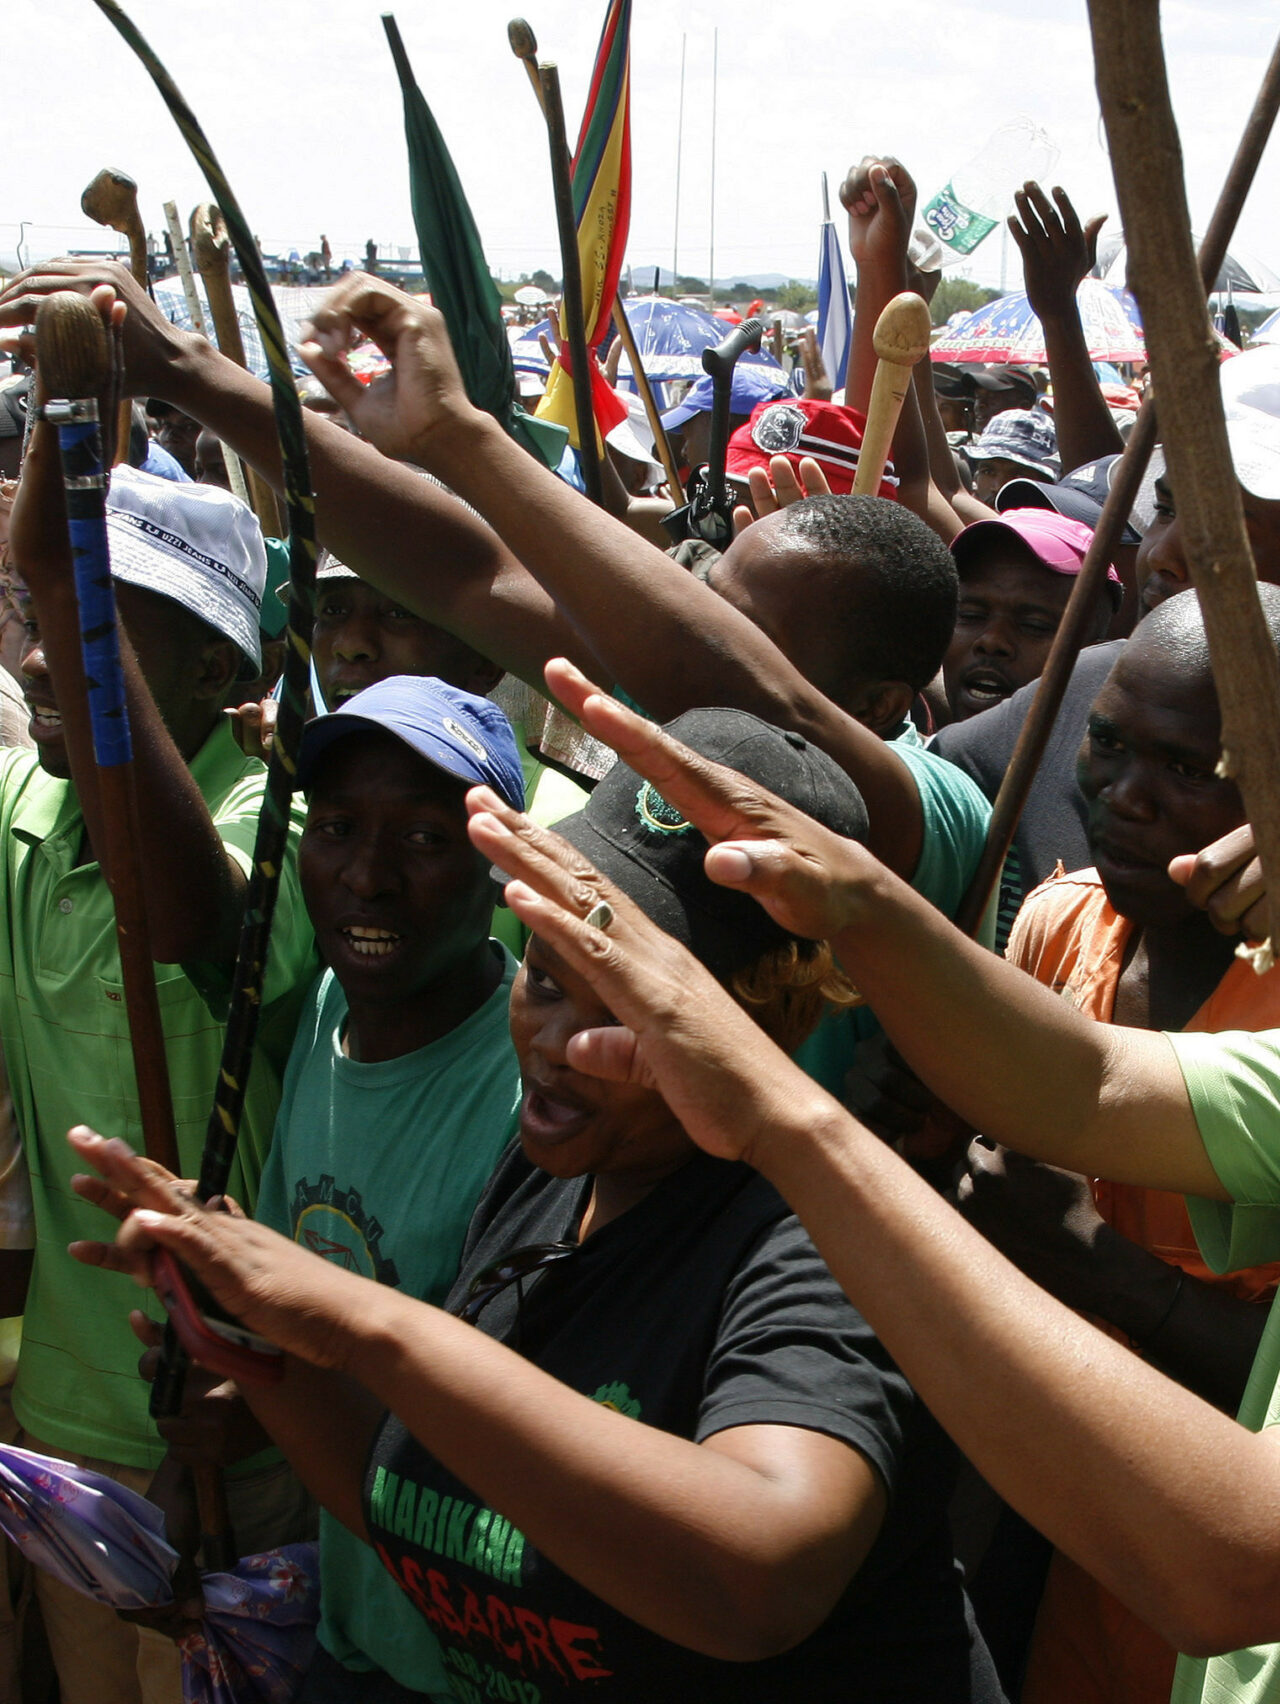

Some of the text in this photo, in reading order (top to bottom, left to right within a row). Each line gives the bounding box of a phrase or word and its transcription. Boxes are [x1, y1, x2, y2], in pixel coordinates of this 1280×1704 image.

[161, 533, 182, 548] UZZI
[183, 544, 212, 566] JEANS
[298, 1180, 379, 1242] AMCU
[371, 1466, 526, 1588] MARIKANA
[376, 1542, 614, 1686] SSACRE
